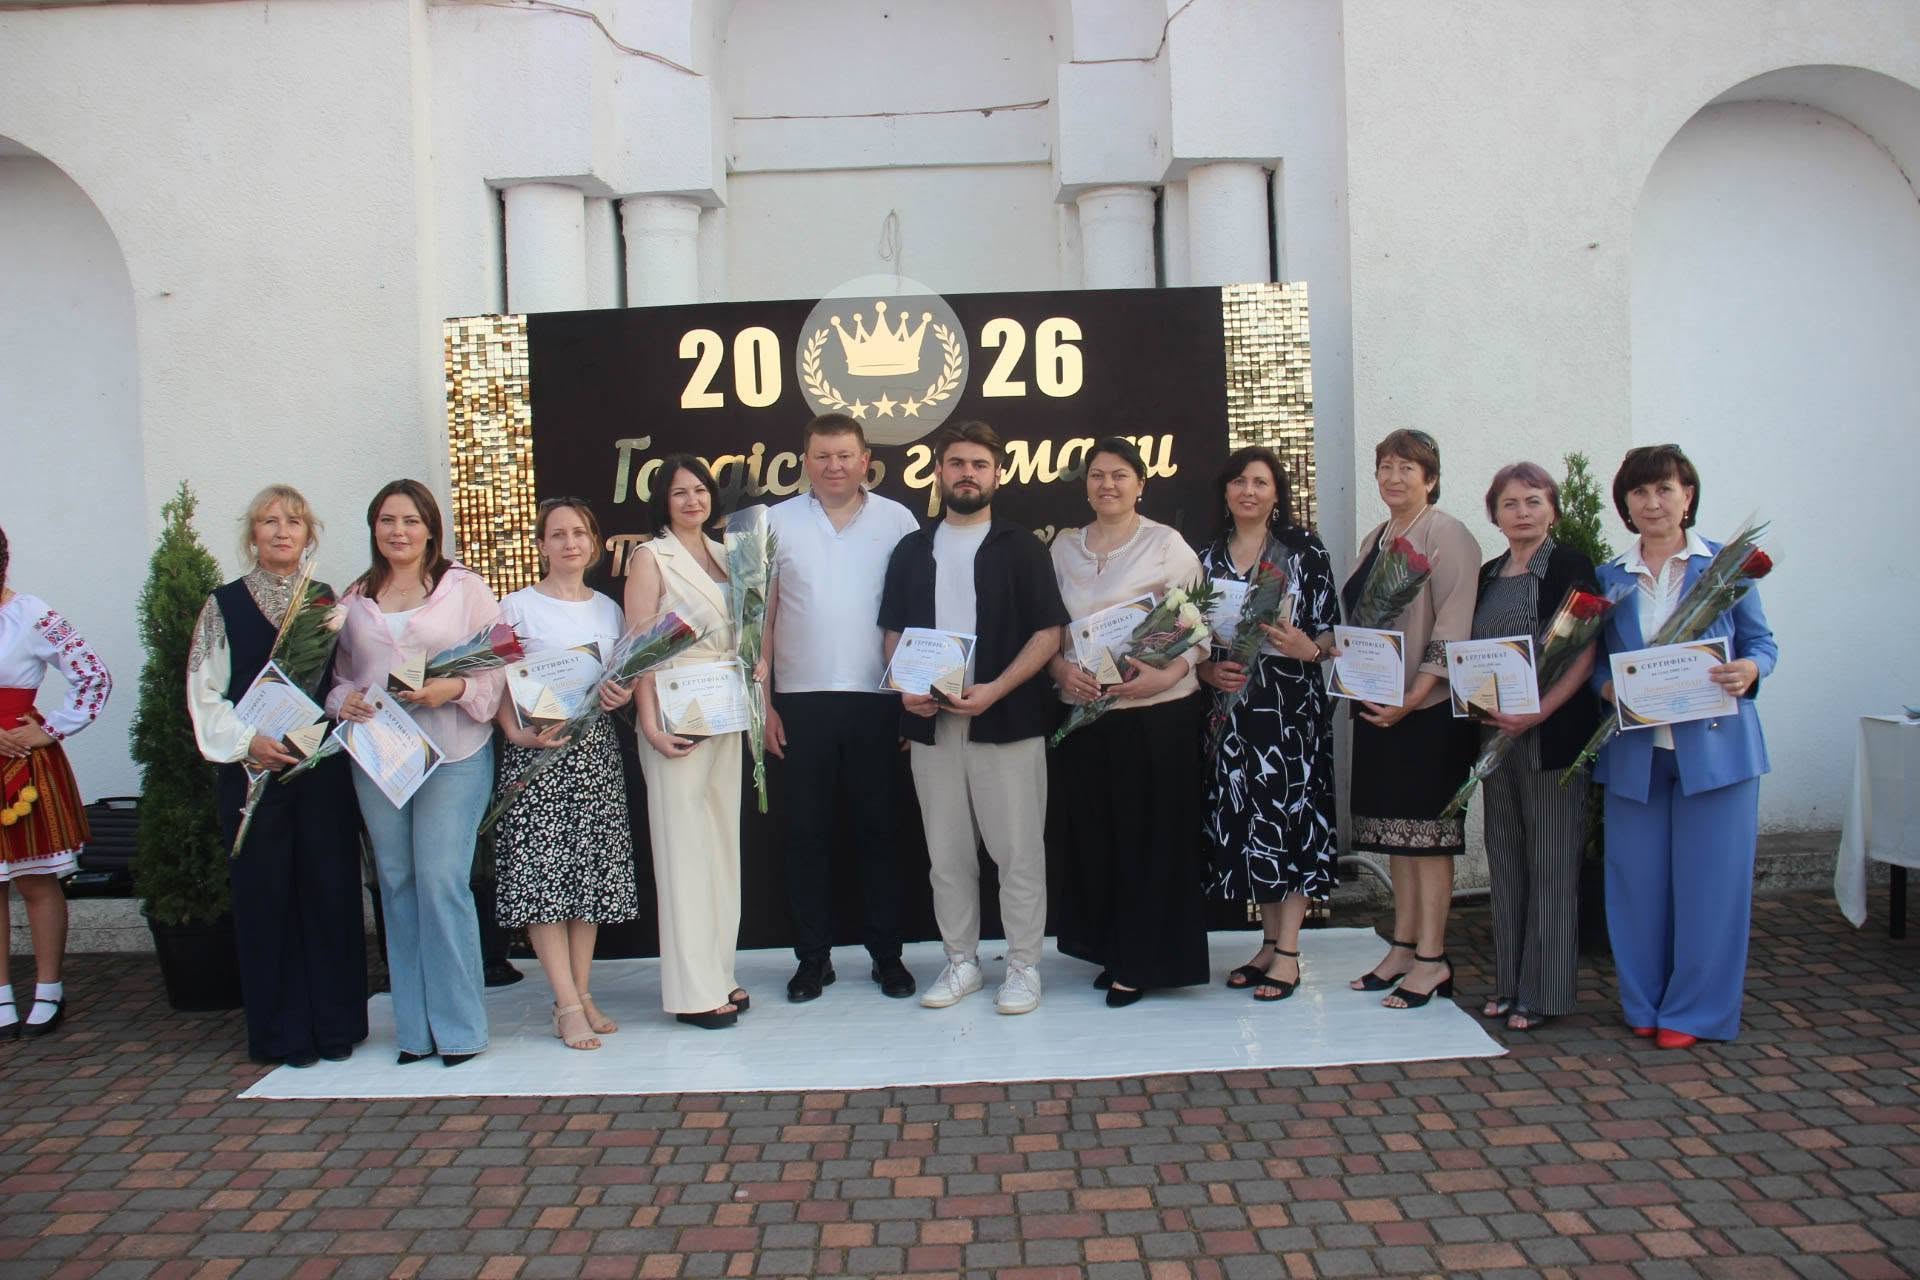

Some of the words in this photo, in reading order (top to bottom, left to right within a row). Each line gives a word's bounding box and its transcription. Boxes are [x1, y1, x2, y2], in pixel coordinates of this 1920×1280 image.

[679, 327, 782, 409] 20
[981, 317, 1083, 398] 26
[1640, 656, 1697, 670] СЕРТИФІКАТ
